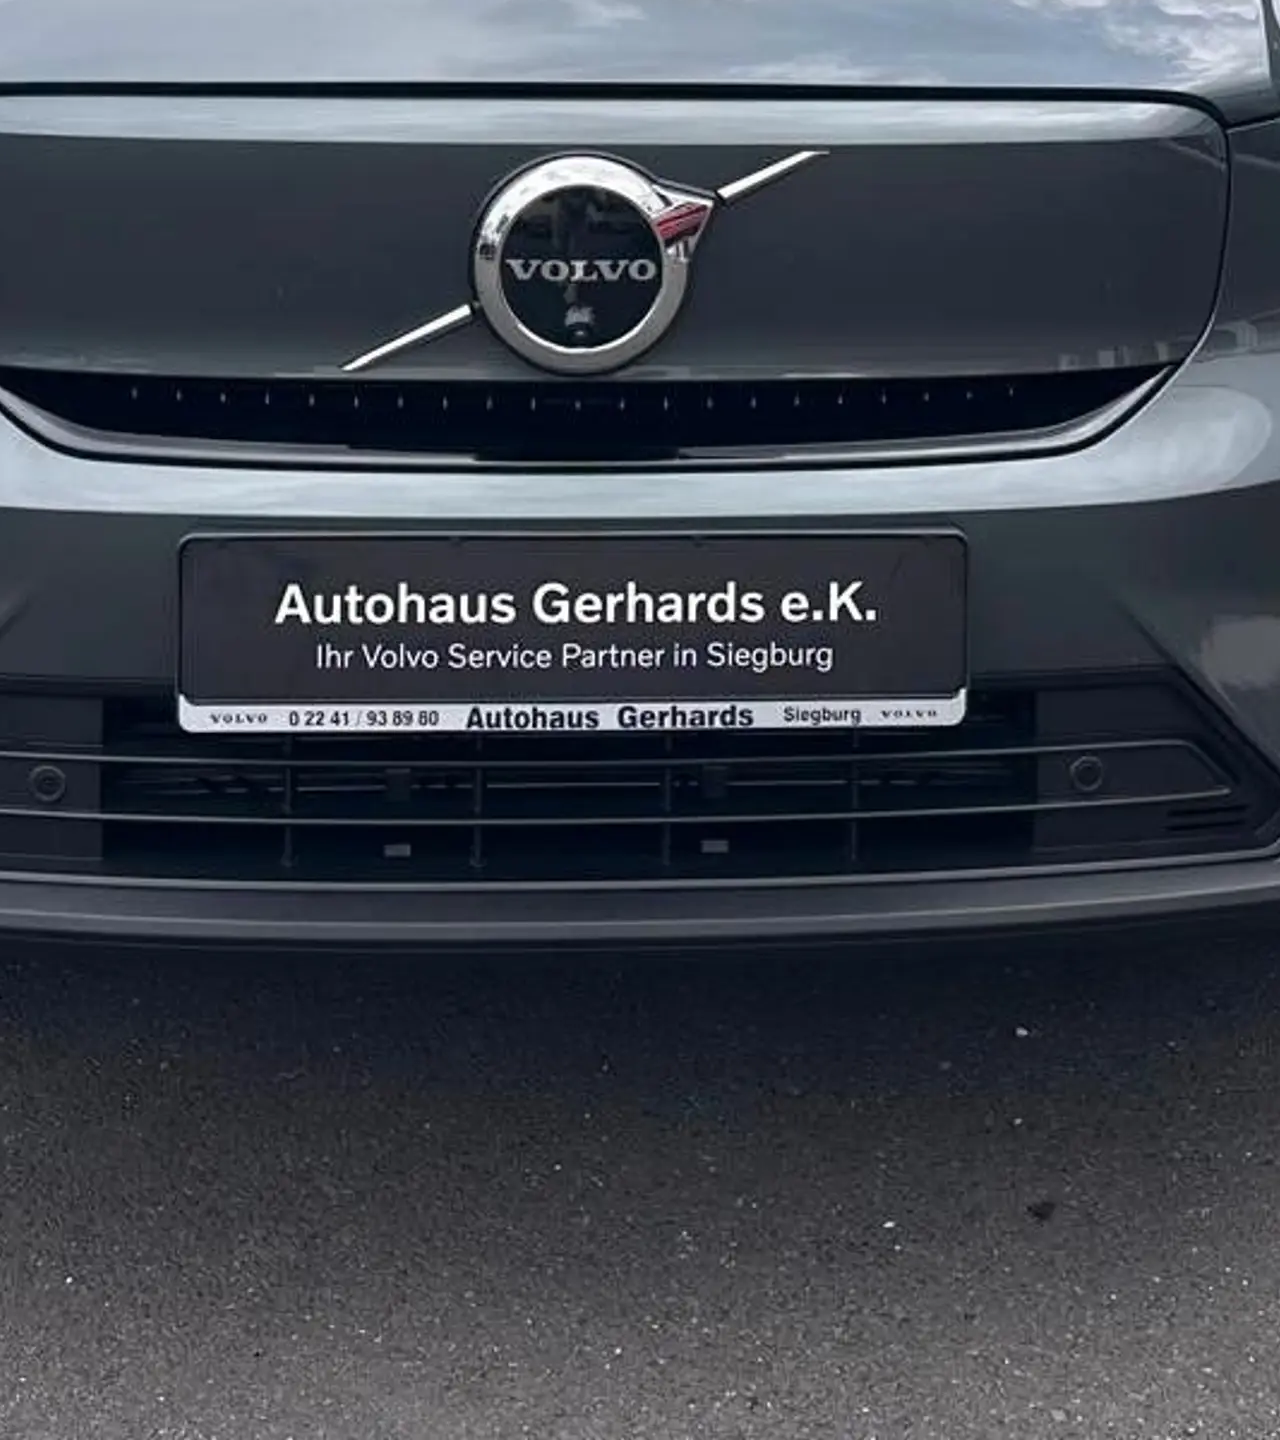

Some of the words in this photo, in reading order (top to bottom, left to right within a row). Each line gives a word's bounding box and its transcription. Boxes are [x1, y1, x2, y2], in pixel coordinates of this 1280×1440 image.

[505, 259, 658, 282] VOLVO
[274, 581, 517, 625] Autohaus
[531, 580, 765, 625] Gerhards
[780, 580, 877, 622] e.K.
[316, 644, 354, 669] Ihr
[361, 643, 440, 669] Volvo
[447, 643, 553, 669] Service
[562, 643, 665, 669] Partner
[673, 643, 697, 667] in
[706, 641, 834, 673] Siegburg
[210, 712, 267, 724] VOLVO
[304, 710, 325, 726] 22
[330, 710, 349, 726] 41
[366, 710, 388, 726] 93
[392, 710, 413, 726] 89
[466, 705, 601, 731] Autohaus
[617, 703, 754, 730] Gerhards
[783, 705, 862, 726] Siegburg
